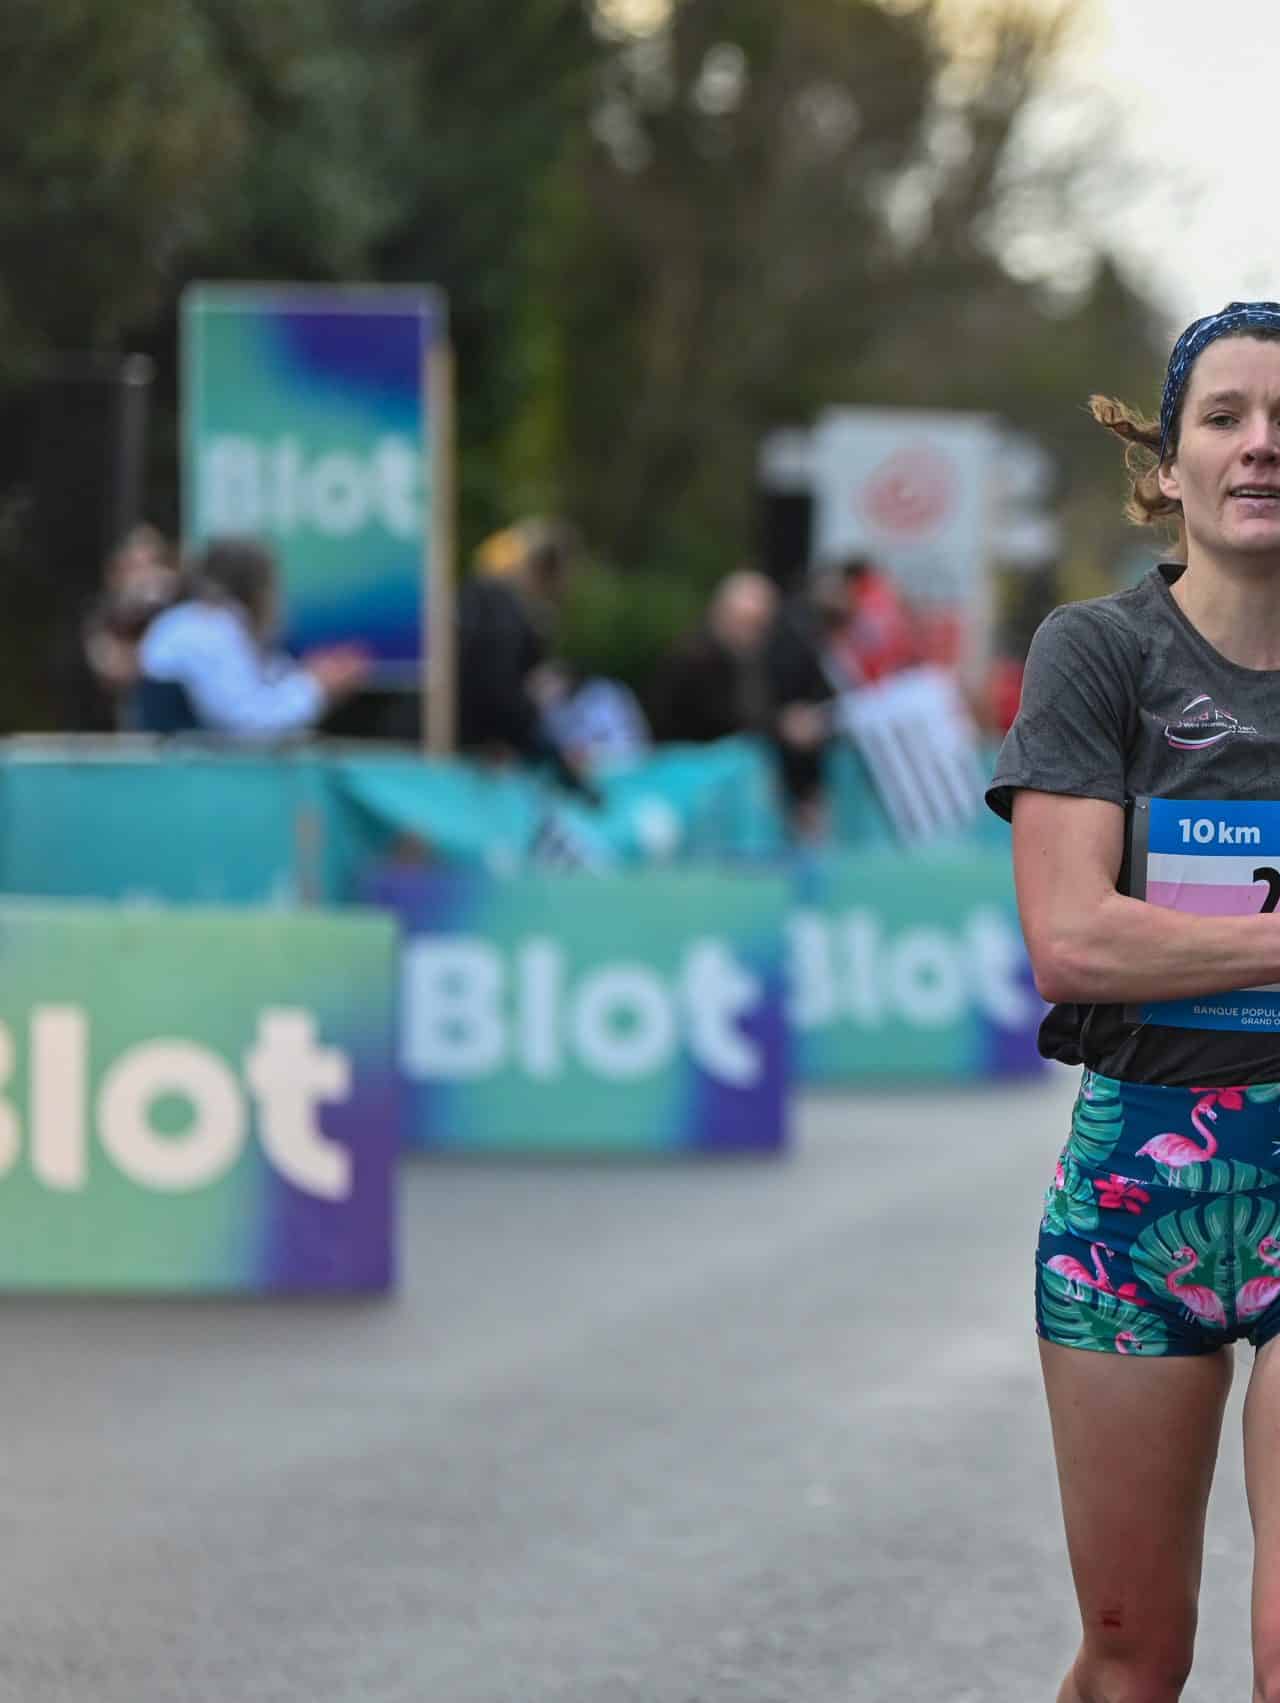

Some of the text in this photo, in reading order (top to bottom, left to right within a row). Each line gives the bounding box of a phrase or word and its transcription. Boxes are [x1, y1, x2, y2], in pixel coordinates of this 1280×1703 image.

[200, 432, 422, 540] Blot
[403, 938, 762, 1088] Blot
[1193, 1005, 1239, 1017] BANQUE
[1241, 1016, 1272, 1025] GRAND
[0, 1006, 352, 1202] lot
